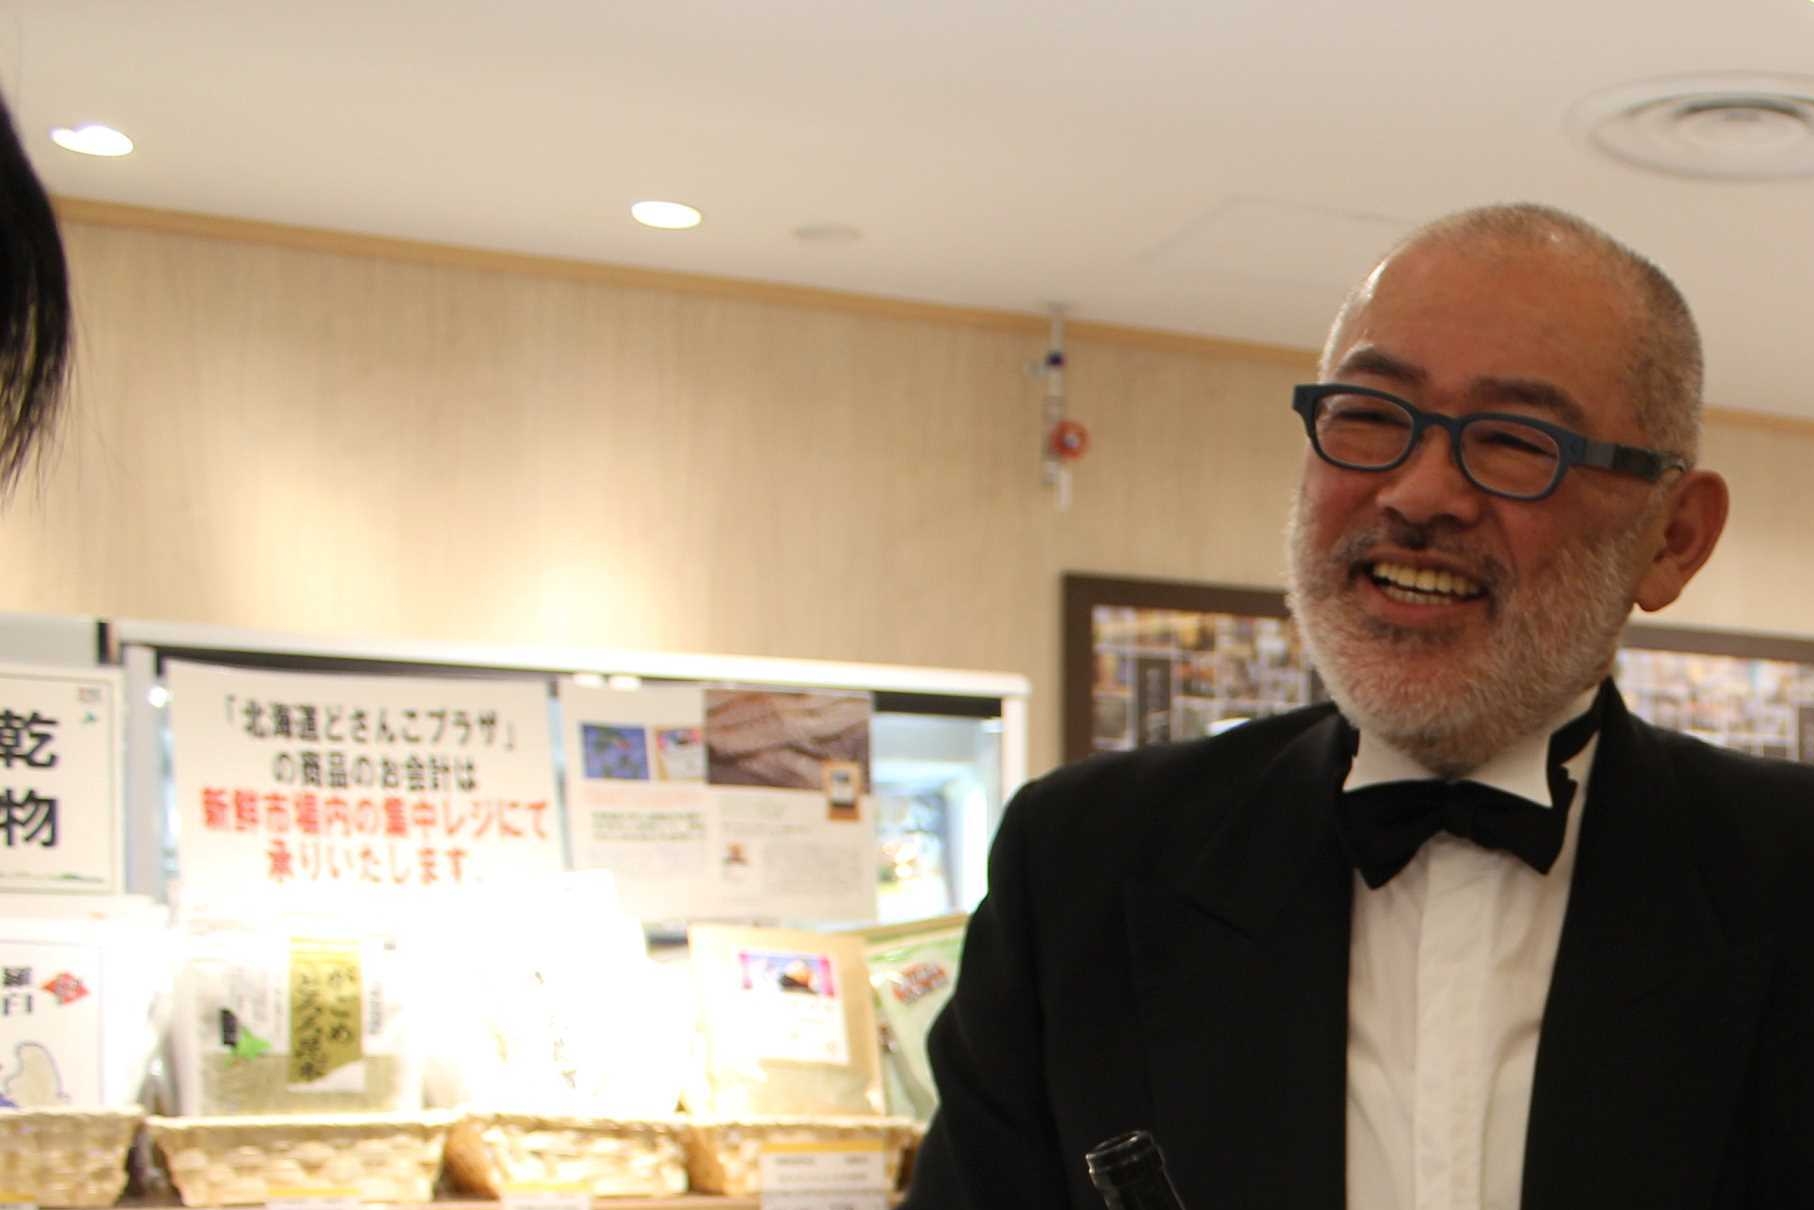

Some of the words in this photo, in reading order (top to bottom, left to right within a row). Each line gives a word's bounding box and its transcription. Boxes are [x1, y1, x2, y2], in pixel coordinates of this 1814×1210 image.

[272, 752, 477, 791] の商品のお会計は
[202, 787, 549, 840] 新鮮市場内の集中レジにて
